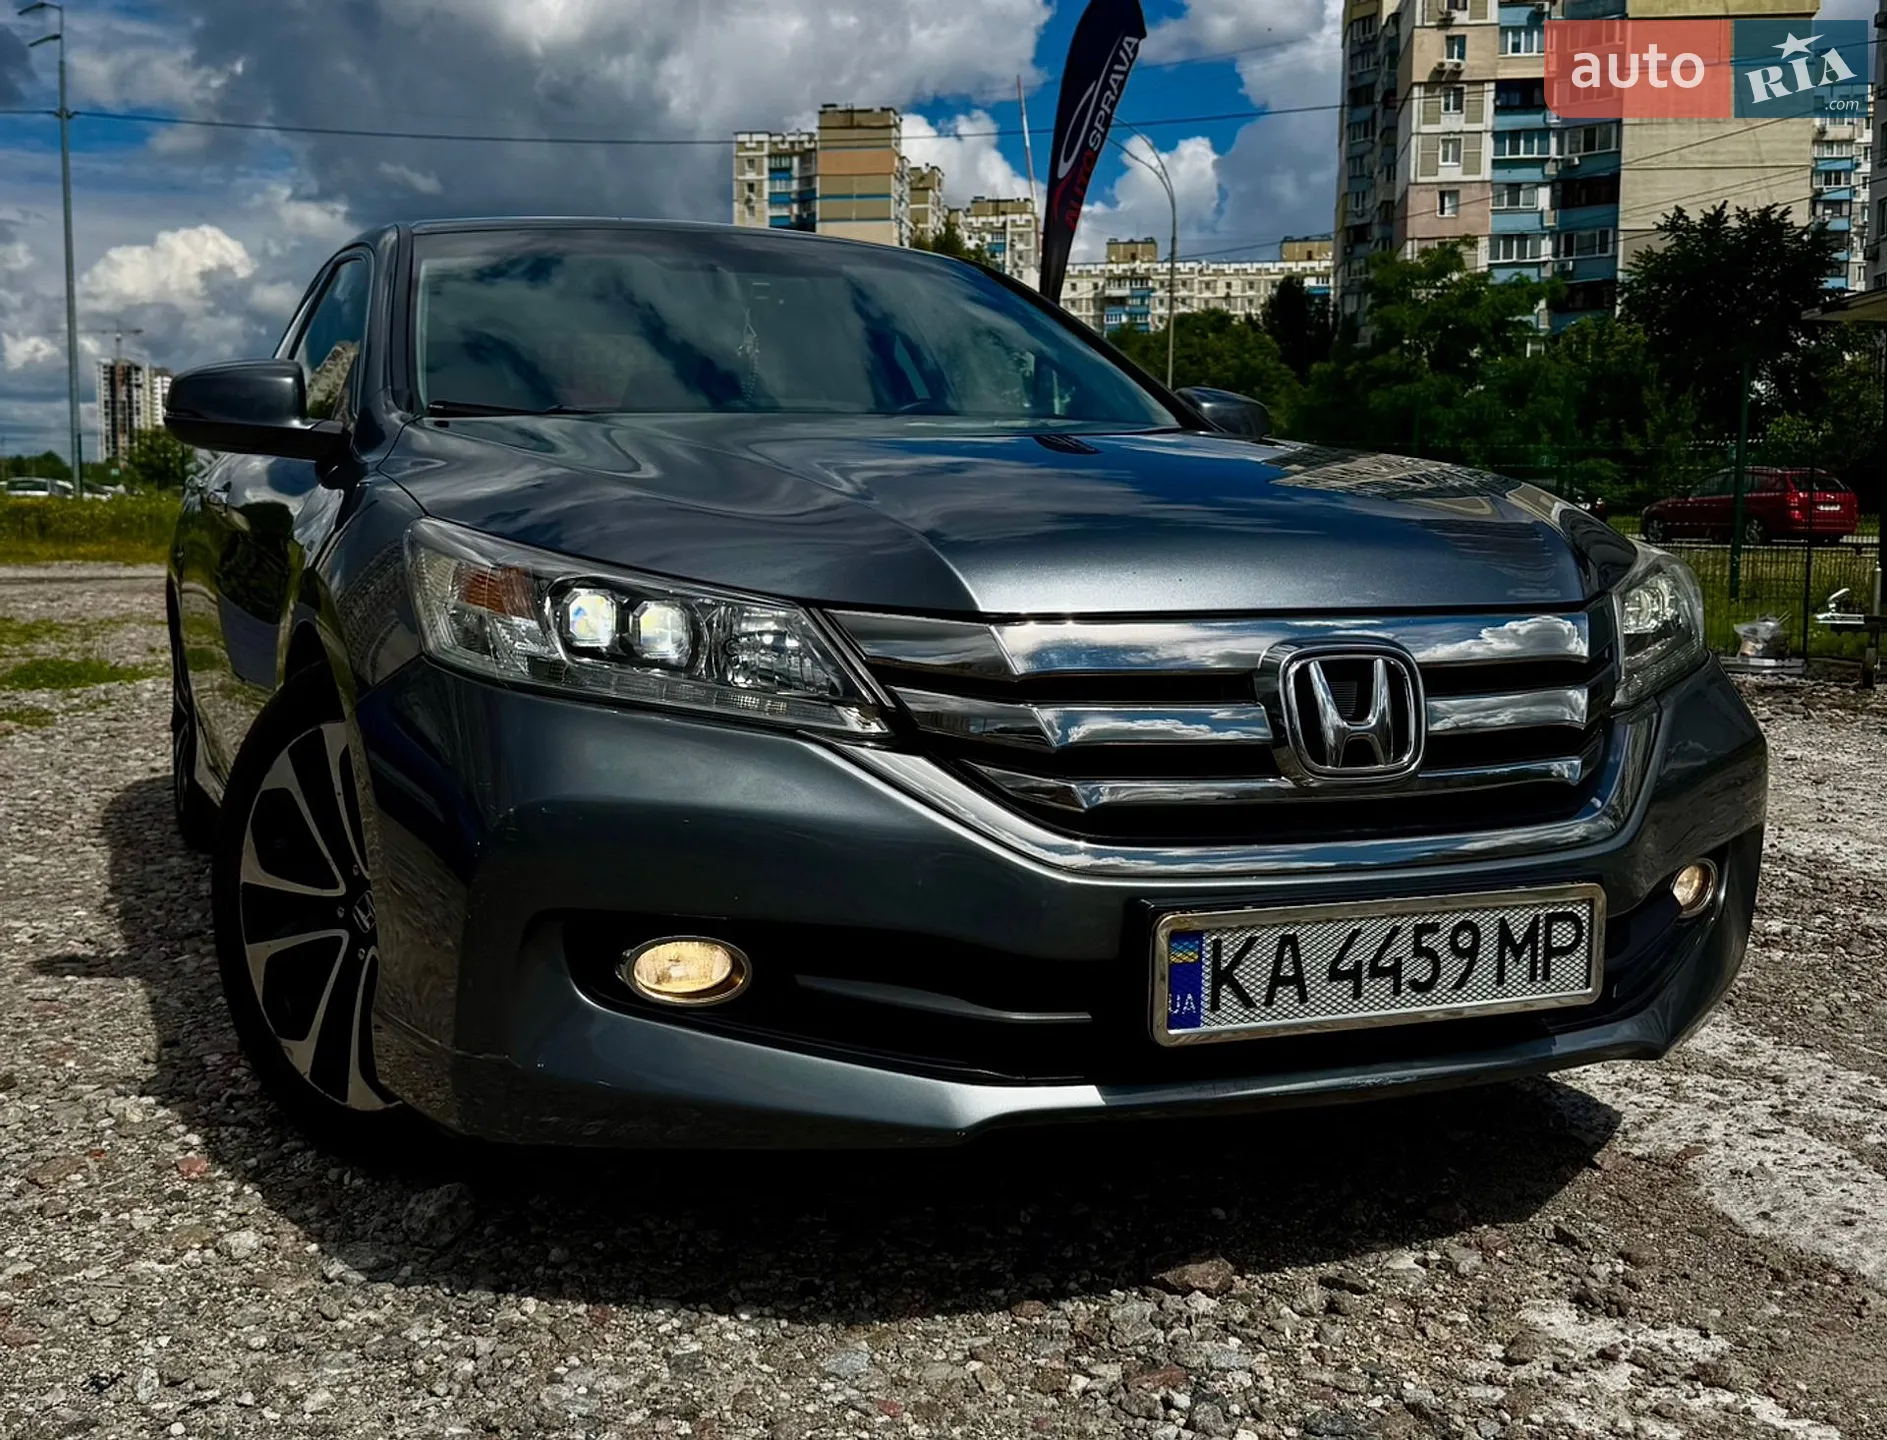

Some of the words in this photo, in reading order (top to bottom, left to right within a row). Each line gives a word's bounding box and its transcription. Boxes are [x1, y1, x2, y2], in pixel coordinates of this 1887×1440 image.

[1210, 933, 1309, 1011] KA
[1328, 920, 1481, 999] 4459
[1499, 911, 1584, 987] MP
[1168, 992, 1197, 1014] UA
